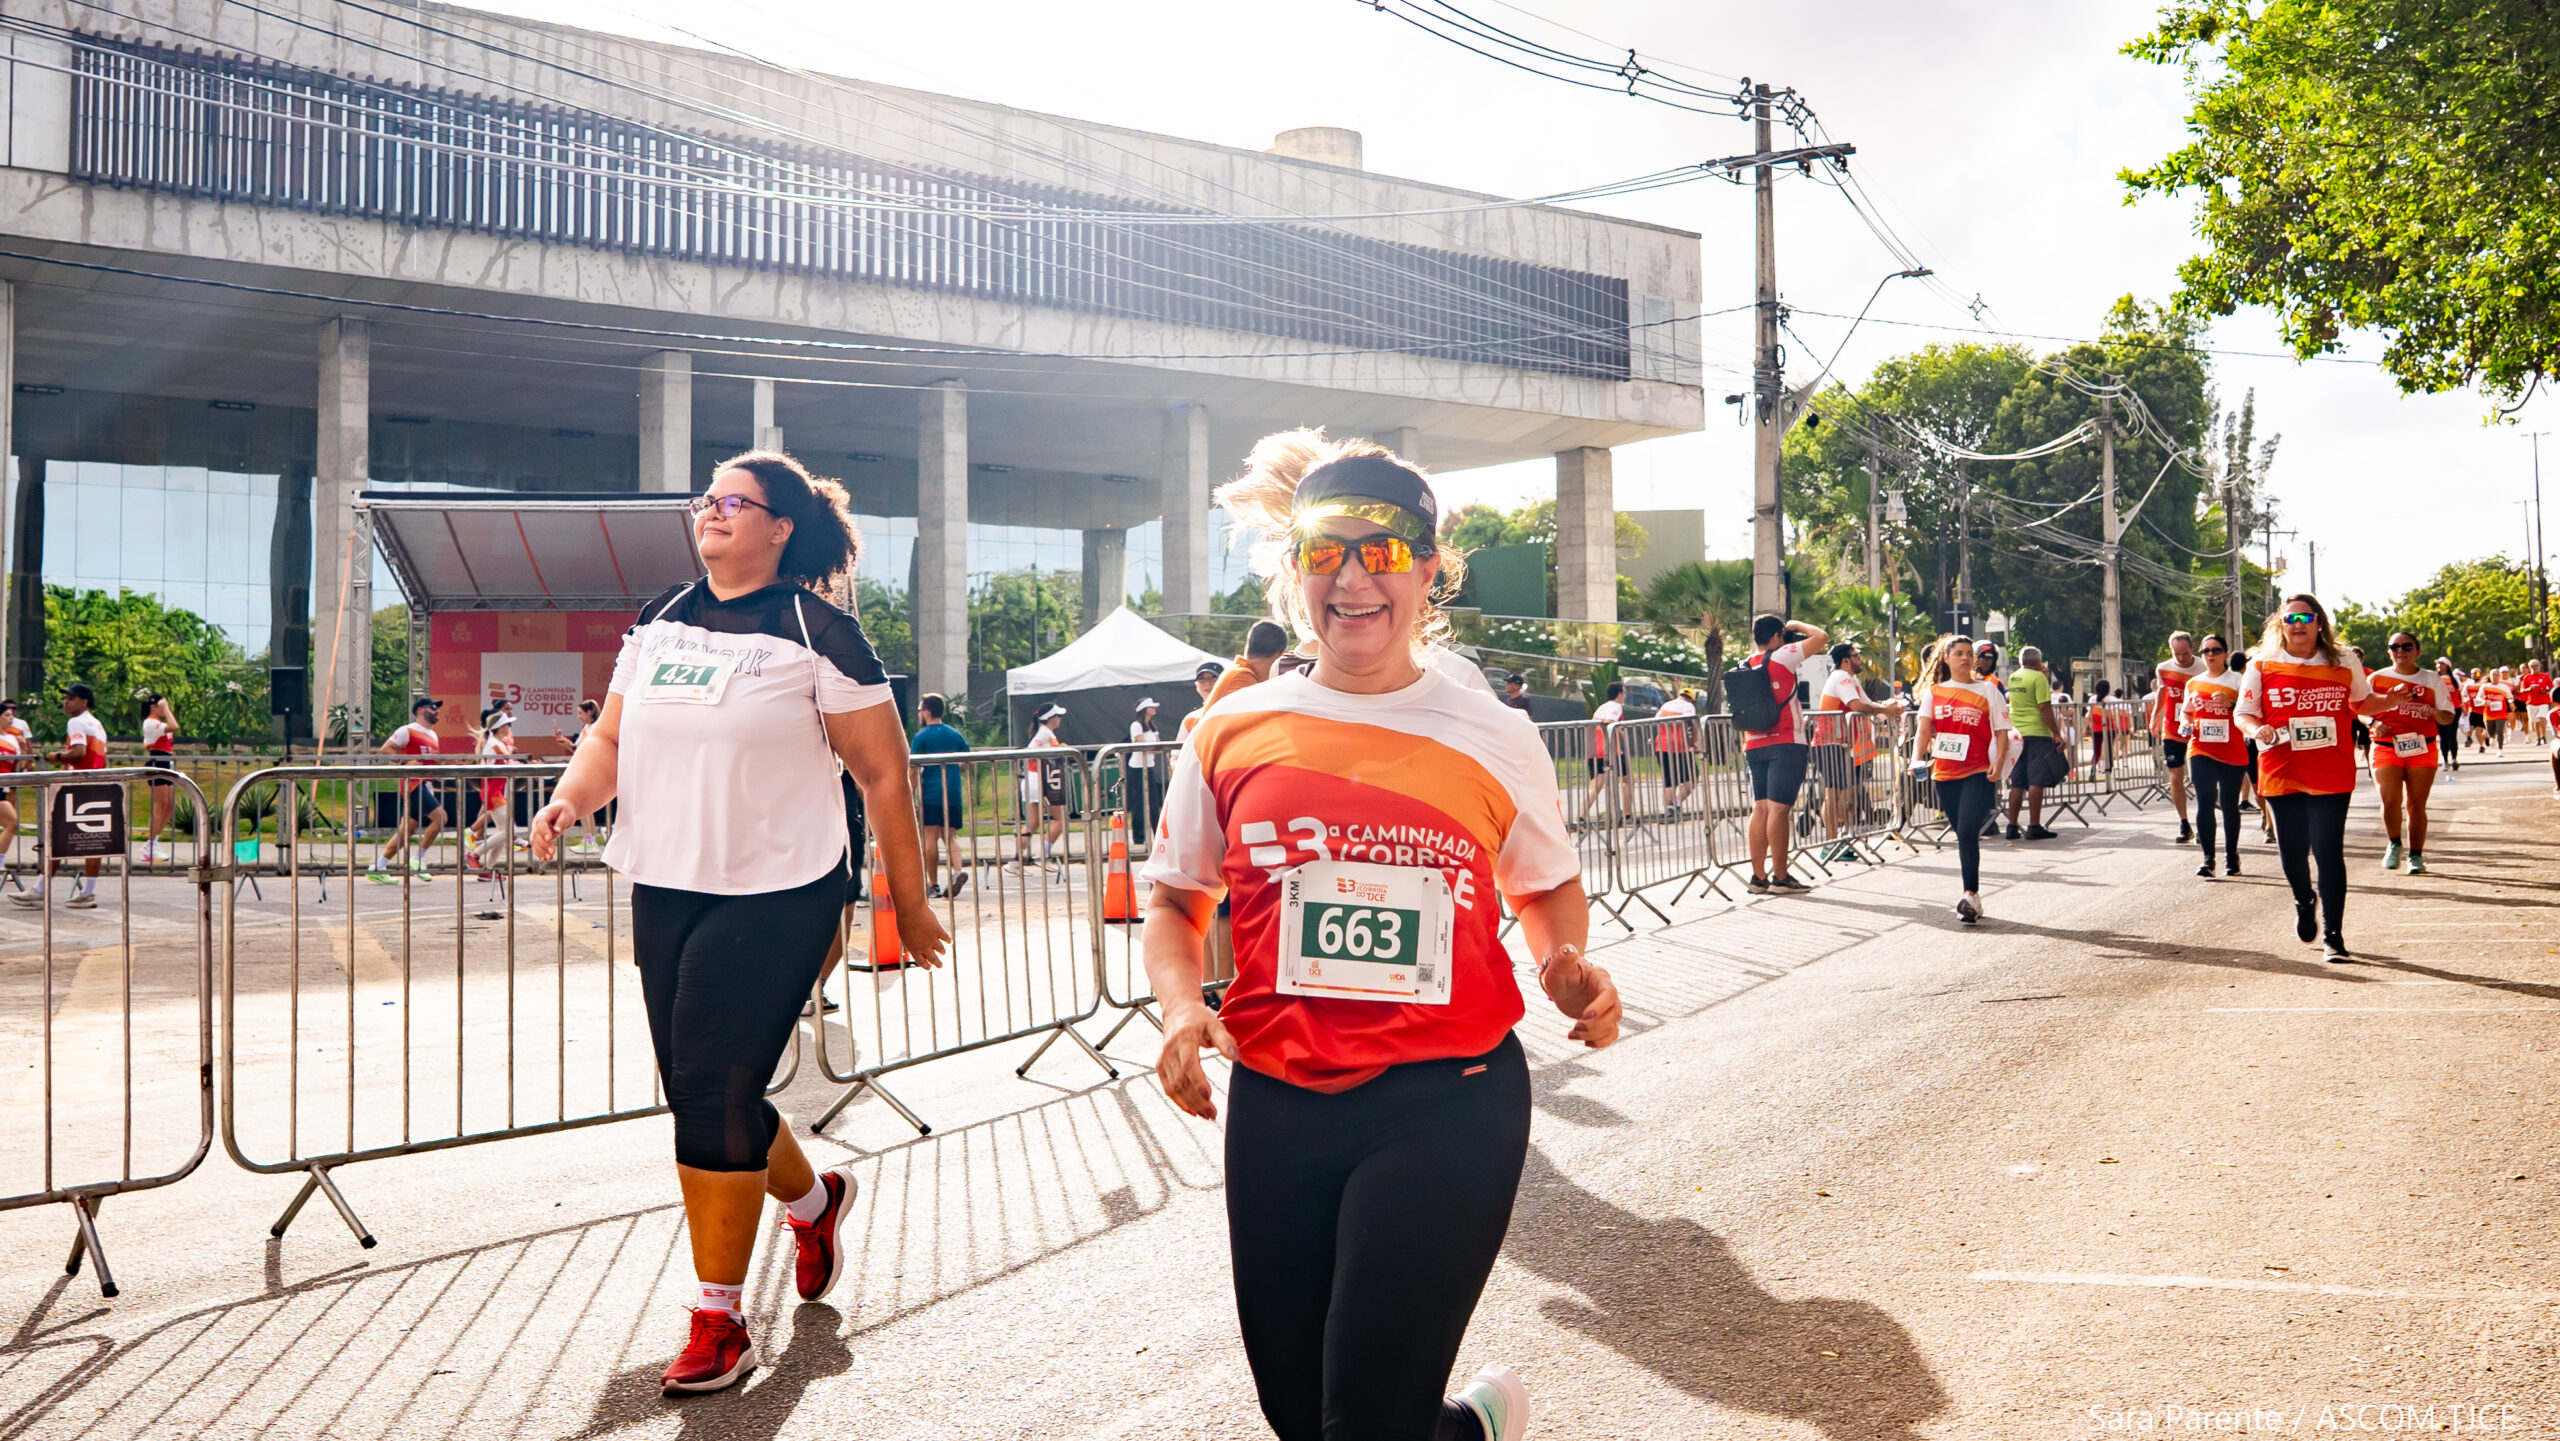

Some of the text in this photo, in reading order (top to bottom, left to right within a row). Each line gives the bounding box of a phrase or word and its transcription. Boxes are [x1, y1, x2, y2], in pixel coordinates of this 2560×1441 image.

[660, 665, 704, 684] 421
[524, 693, 575, 702] /CORRIDA
[524, 703, 574, 715] DO TJCE
[2297, 699, 2342, 712] DO TJCE
[2203, 726, 2223, 736] 1402
[2300, 728, 2323, 739] 578
[1942, 742, 1959, 752] 763
[2399, 740, 2420, 751] 1207
[1347, 824, 1476, 862] CAMINHADA
[1289, 881, 1300, 908] 3KM
[1367, 892, 1386, 902] TJCE
[1317, 907, 1402, 960] 663
